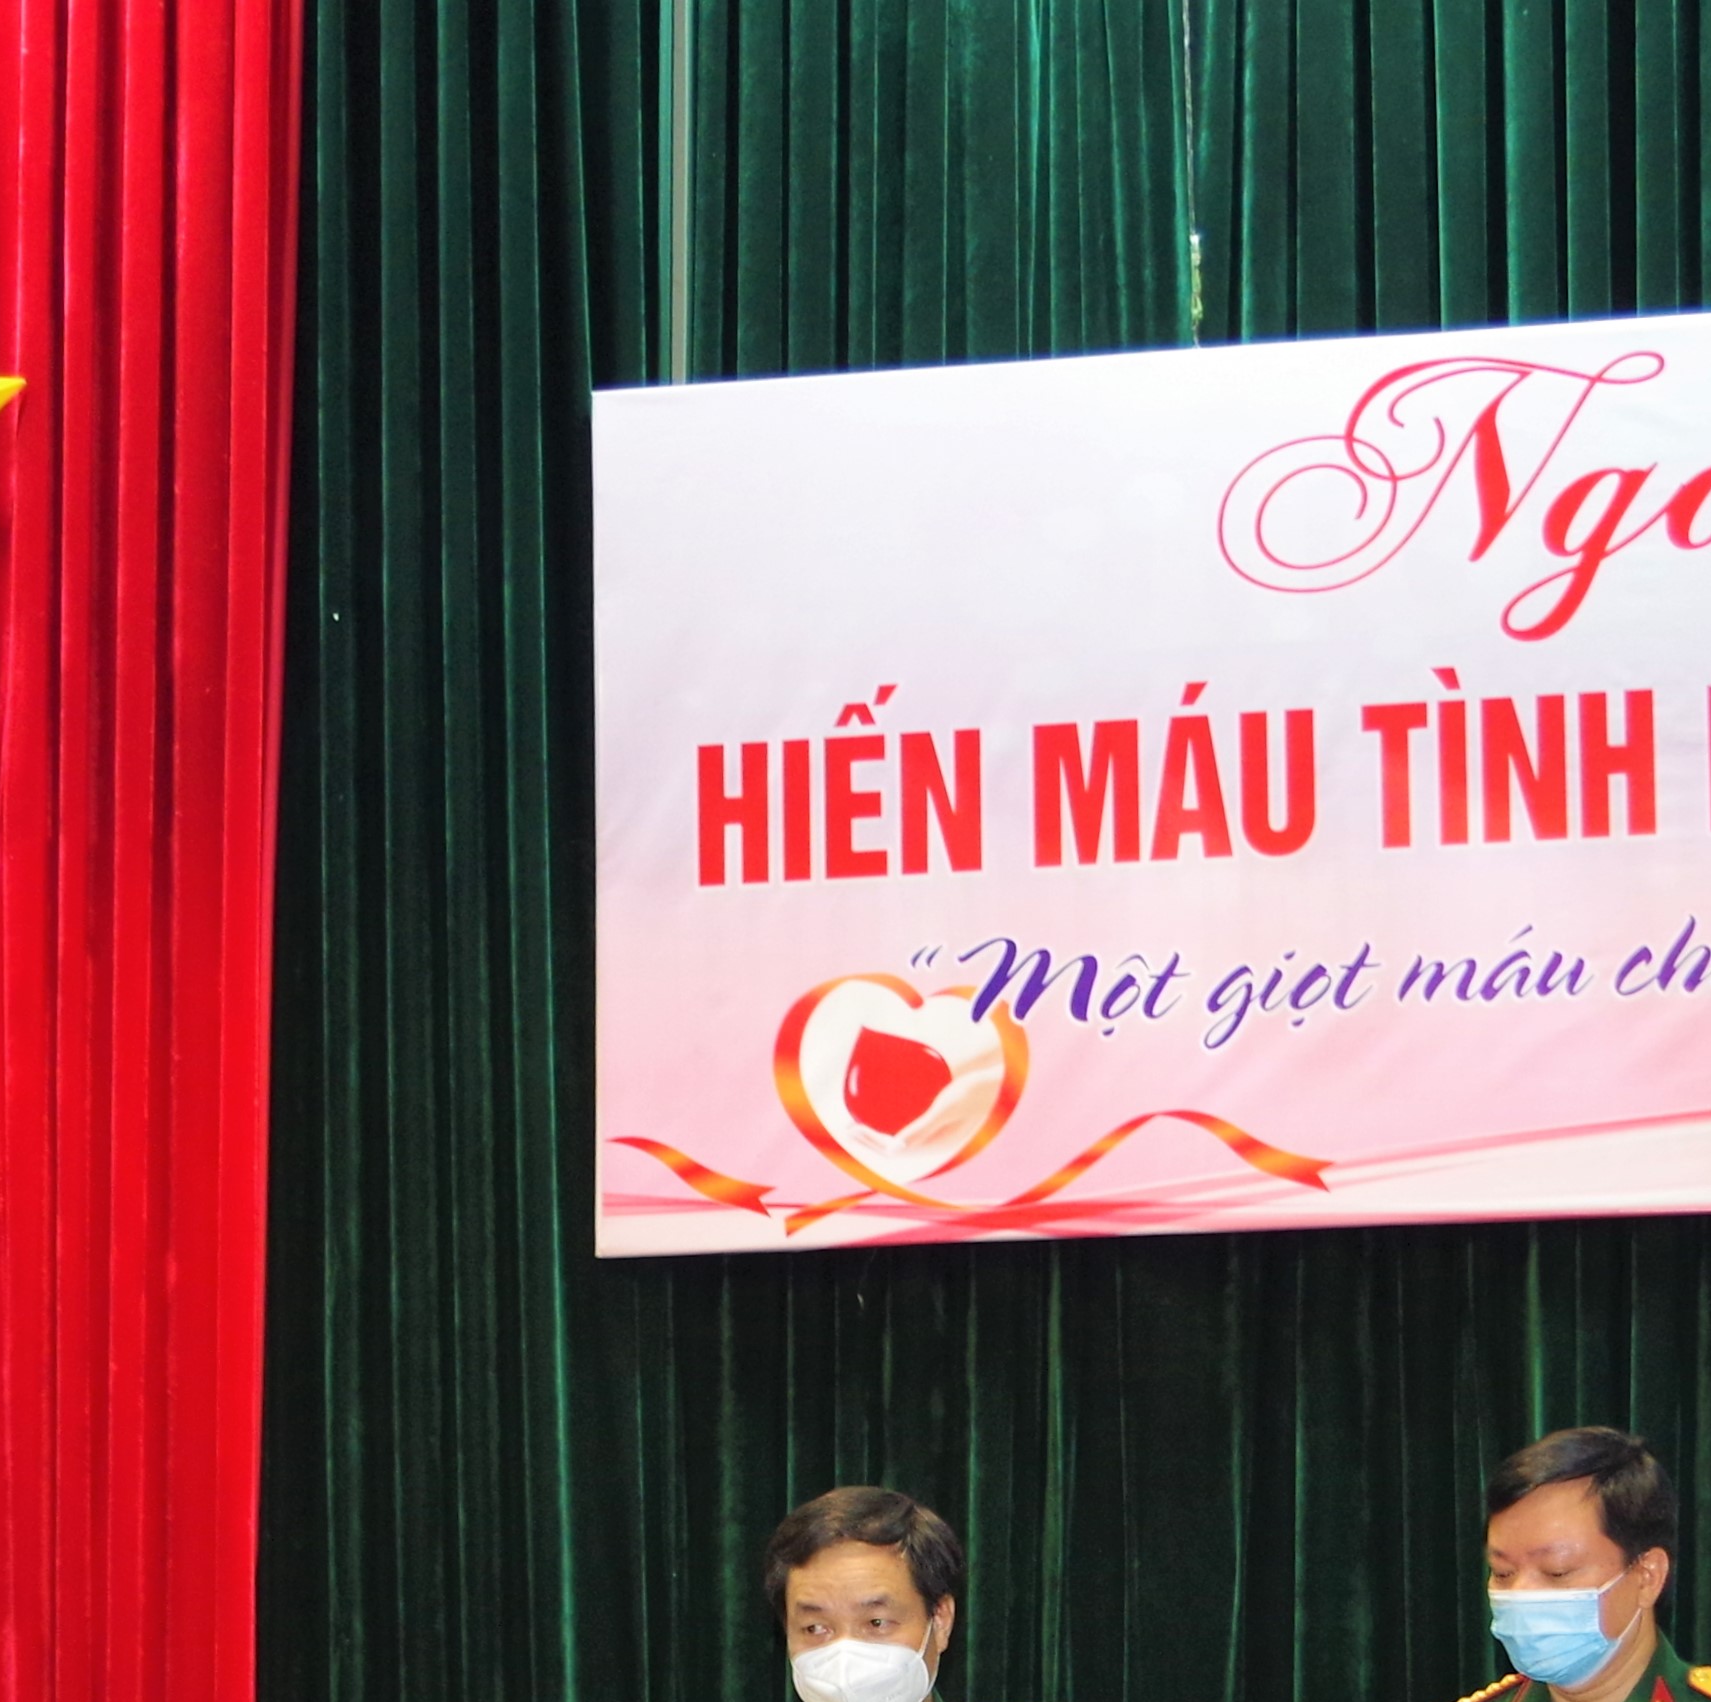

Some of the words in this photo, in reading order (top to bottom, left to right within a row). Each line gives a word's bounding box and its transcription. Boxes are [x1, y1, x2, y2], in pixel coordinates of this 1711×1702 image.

[695, 684, 984, 887] HIẾN
[1031, 682, 1318, 869] MÁU
[1361, 667, 1657, 850] TÌNH
[1204, 943, 1380, 1049] giọt
[1398, 925, 1589, 1004] máu
